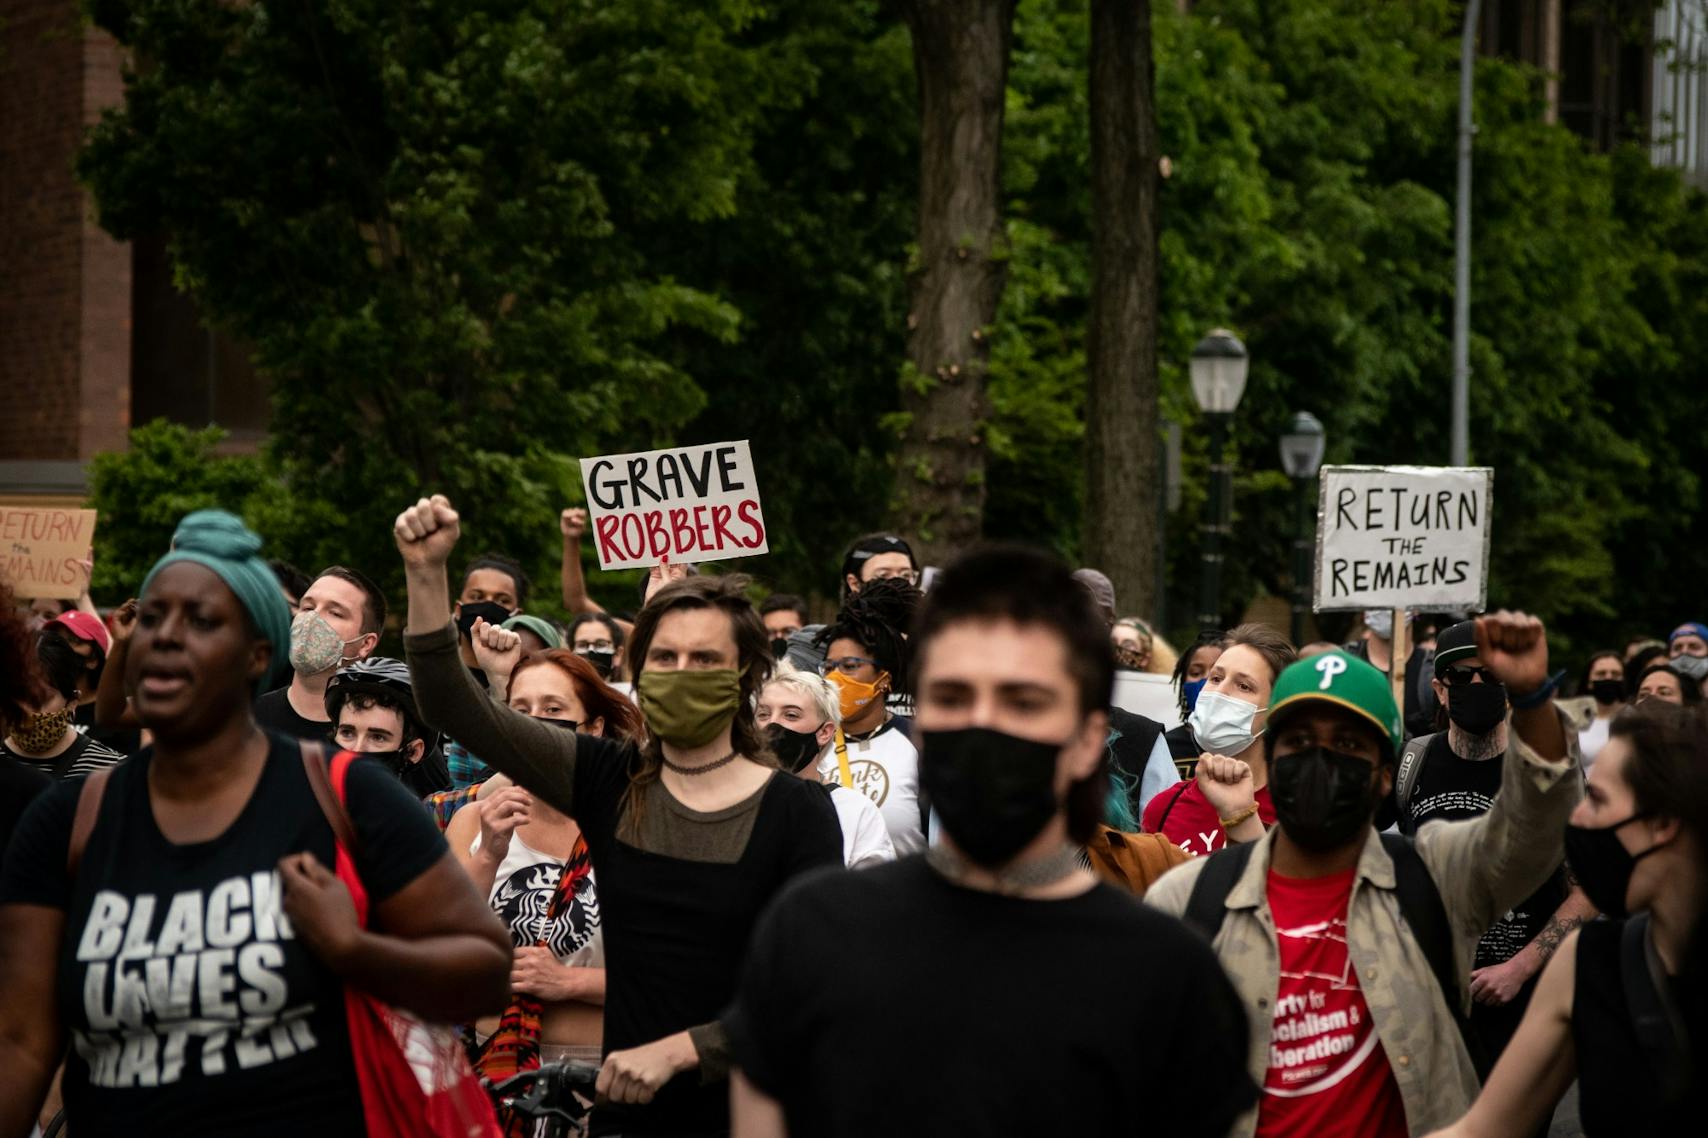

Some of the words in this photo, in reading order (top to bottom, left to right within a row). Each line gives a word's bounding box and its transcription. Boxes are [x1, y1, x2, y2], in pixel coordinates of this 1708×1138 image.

[588, 446, 745, 510] GRAVE
[0, 510, 84, 542] ETURN
[1336, 487, 1478, 532] RETURN
[596, 499, 764, 564] ROBBERS
[1381, 536, 1427, 556] THE
[1331, 556, 1470, 598] REMAINS
[1315, 654, 1348, 690] P
[1395, 751, 1415, 796] OGIO
[76, 868, 295, 963] BLACK
[1308, 989, 1327, 1010] for
[1349, 1003, 1361, 1026] &
